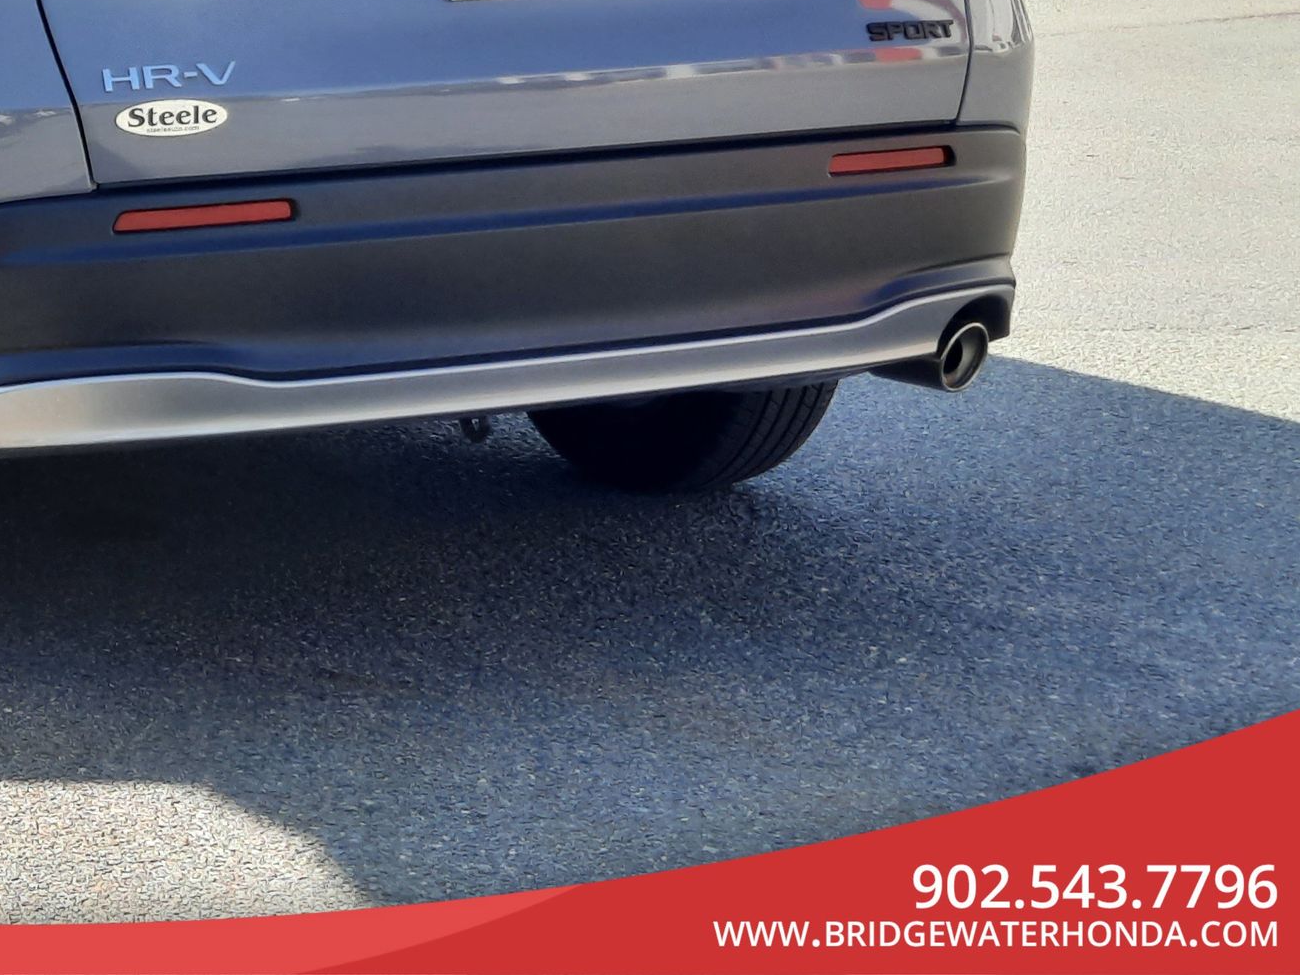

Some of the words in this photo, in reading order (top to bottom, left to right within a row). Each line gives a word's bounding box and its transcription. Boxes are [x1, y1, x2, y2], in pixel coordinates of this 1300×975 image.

[866, 20, 954, 41] SPORT
[102, 60, 236, 92] HR-V
[127, 105, 217, 128] Steele
